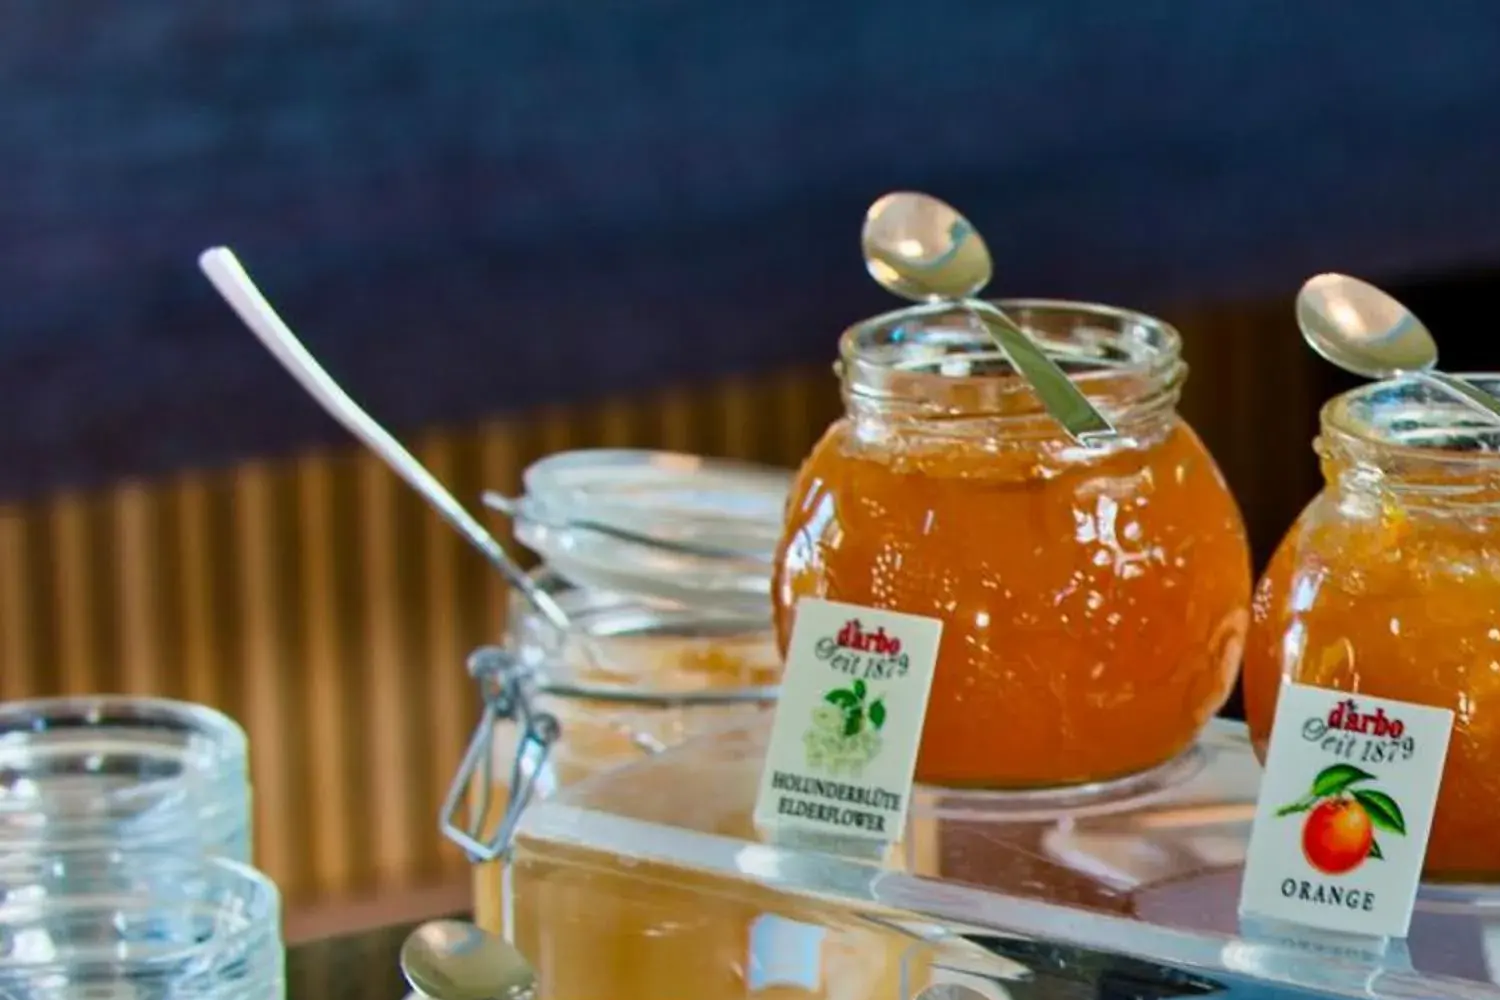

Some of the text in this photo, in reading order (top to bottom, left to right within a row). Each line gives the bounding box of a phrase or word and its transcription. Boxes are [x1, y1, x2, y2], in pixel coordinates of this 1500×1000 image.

[815, 636, 909, 679] Seit 1879
[1302, 717, 1414, 762] Seit 1879
[778, 797, 885, 832] ELDERFLOWER
[1281, 878, 1375, 911] ORANGE
